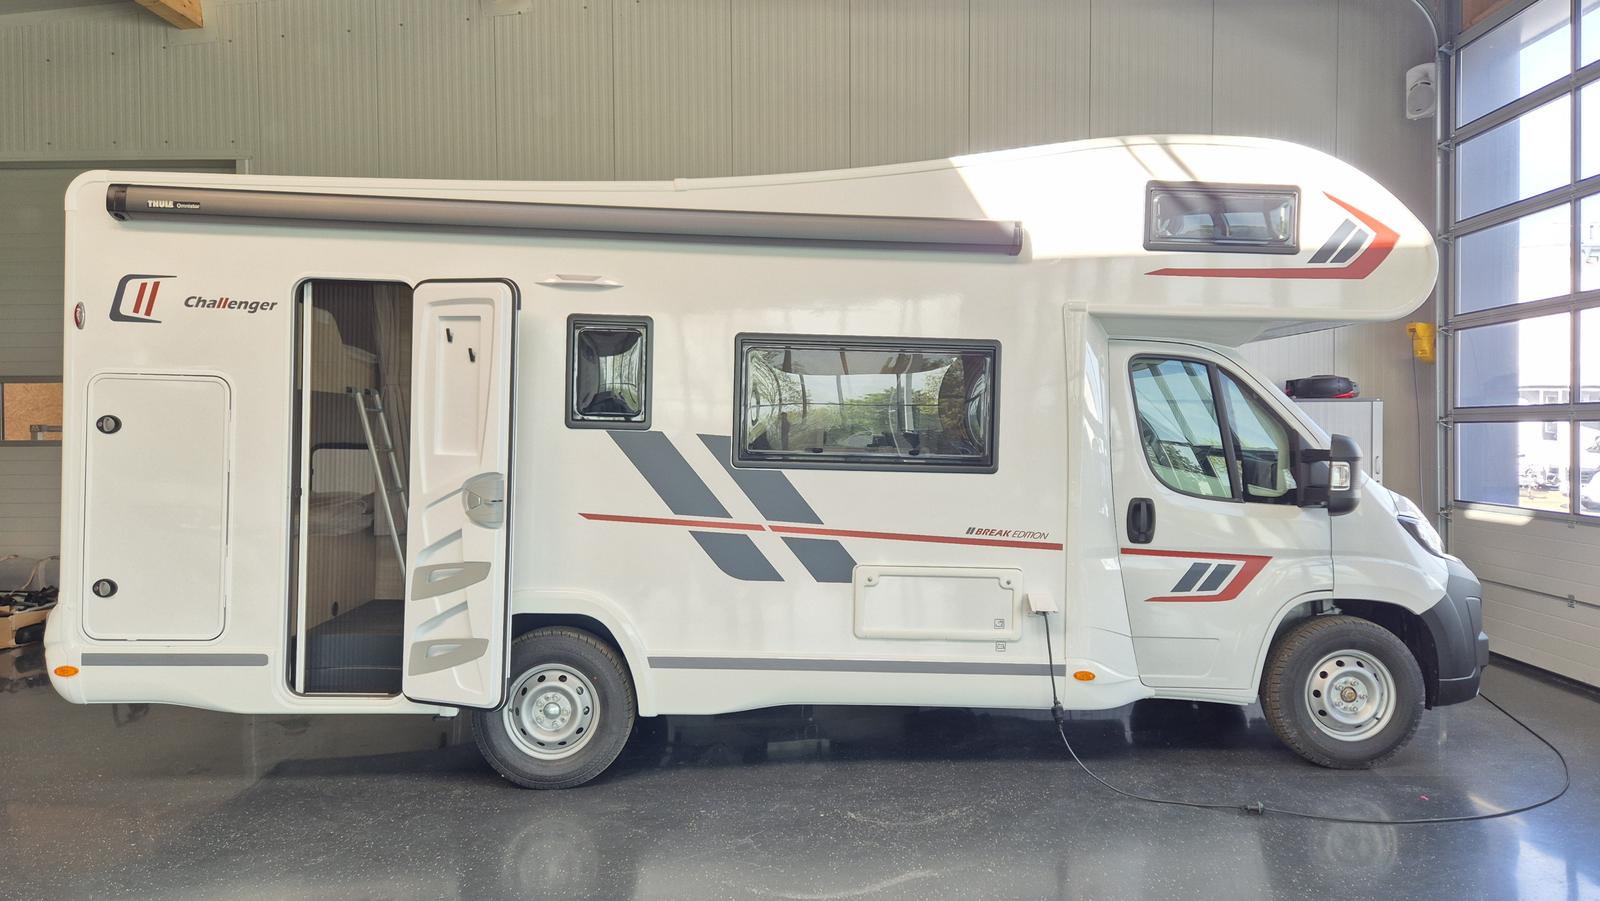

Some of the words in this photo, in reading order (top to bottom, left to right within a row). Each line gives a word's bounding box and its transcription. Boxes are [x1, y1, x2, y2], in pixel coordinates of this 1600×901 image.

[147, 200, 174, 208] THULE
[184, 295, 278, 314] Challenger
[975, 528, 1012, 537] BREAK
[1012, 530, 1049, 540] EDITION
